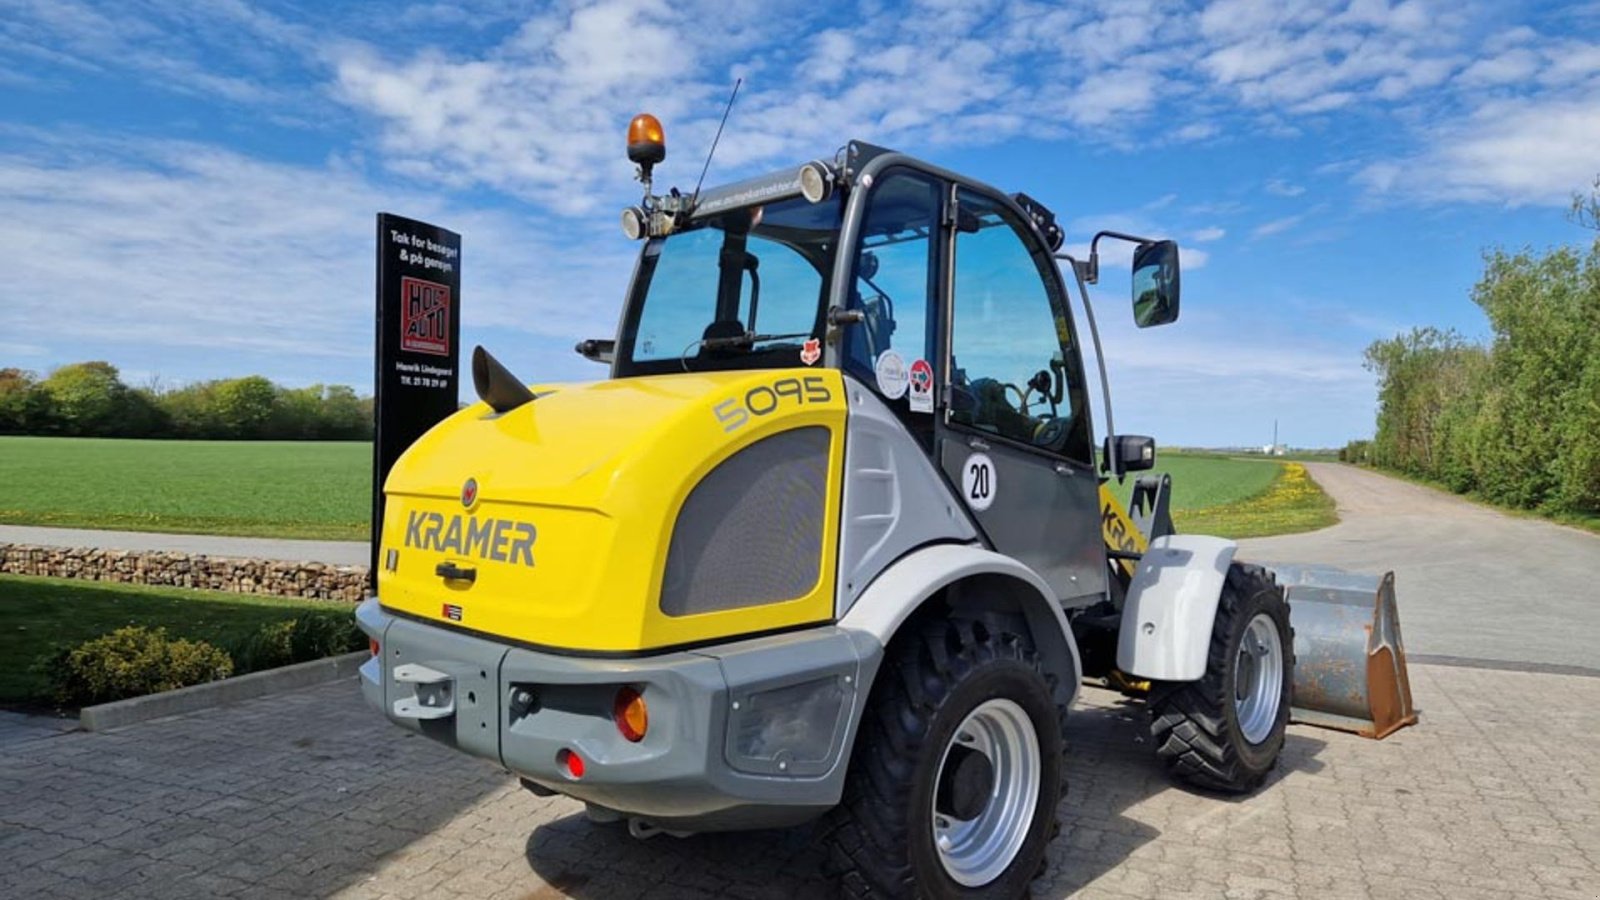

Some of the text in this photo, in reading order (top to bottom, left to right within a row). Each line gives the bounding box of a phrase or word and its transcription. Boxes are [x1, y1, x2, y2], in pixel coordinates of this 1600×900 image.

[390, 229, 410, 245] Tak
[411, 234, 426, 249] for
[399, 248, 409, 261] &
[408, 308, 445, 340] AUTO
[714, 377, 831, 432] 5095
[970, 464, 989, 498] 20
[405, 510, 537, 567] KRAMER
[1102, 501, 1137, 551] KRA
